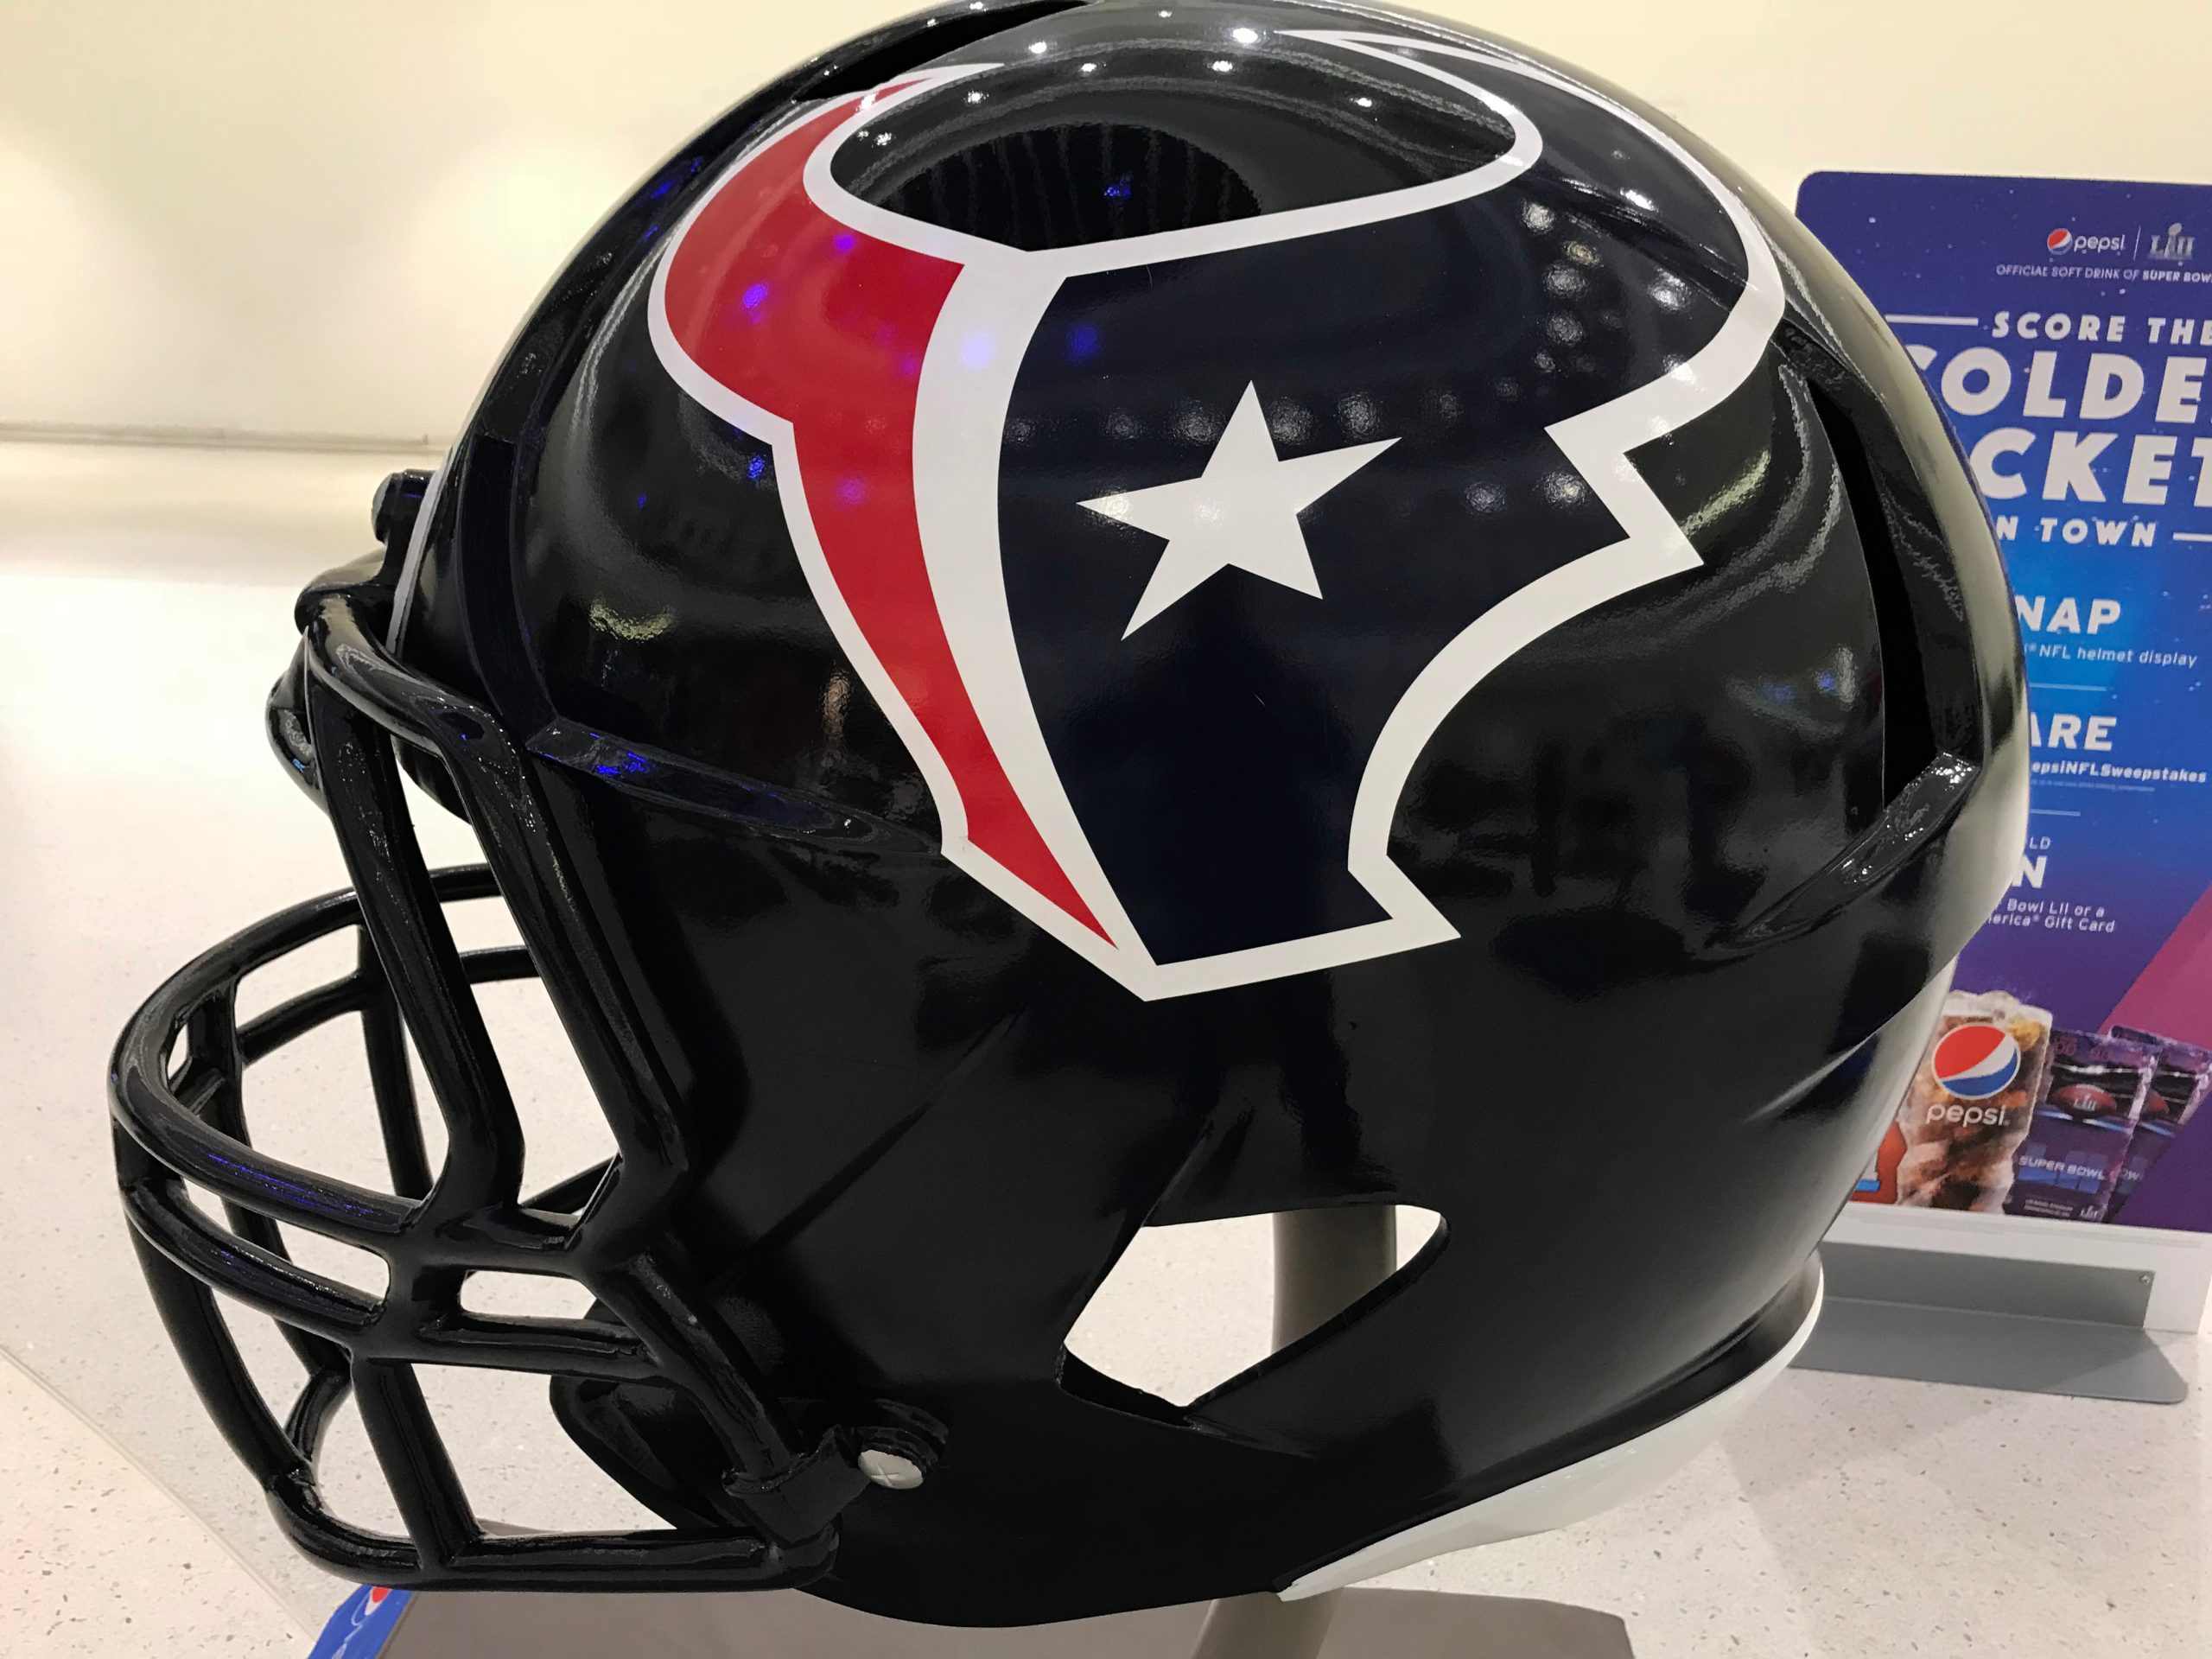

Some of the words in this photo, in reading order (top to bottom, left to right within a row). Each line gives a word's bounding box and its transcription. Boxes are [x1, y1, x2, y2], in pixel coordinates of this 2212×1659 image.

[2074, 234, 2126, 253] pepsi
[1996, 264, 2049, 276] OFFICIAL
[2051, 265, 2082, 277] SOFT
[2084, 267, 2120, 279] DRINK
[2123, 269, 2140, 280] OF
[2142, 270, 2180, 282] SUPER
[2183, 271, 2212, 283] BOW
[1992, 311, 2126, 342] SCORE
[2147, 318, 2212, 346] THE
[1904, 345, 2212, 423] OLDE
[2040, 518, 2156, 547] TOWN
[2039, 644, 2071, 659] NFL
[2077, 647, 2133, 663] helmet
[2139, 650, 2197, 669] display
[2007, 898, 2044, 913] Bowl
[2074, 905, 2091, 917] or
[2095, 907, 2105, 918] a
[2044, 915, 2074, 930] Gift
[2078, 918, 2116, 933] Card
[1925, 1103, 2005, 1128] pepsi
[2018, 1154, 2065, 1171] SUPER
[2067, 1163, 2106, 1180] BOWL
